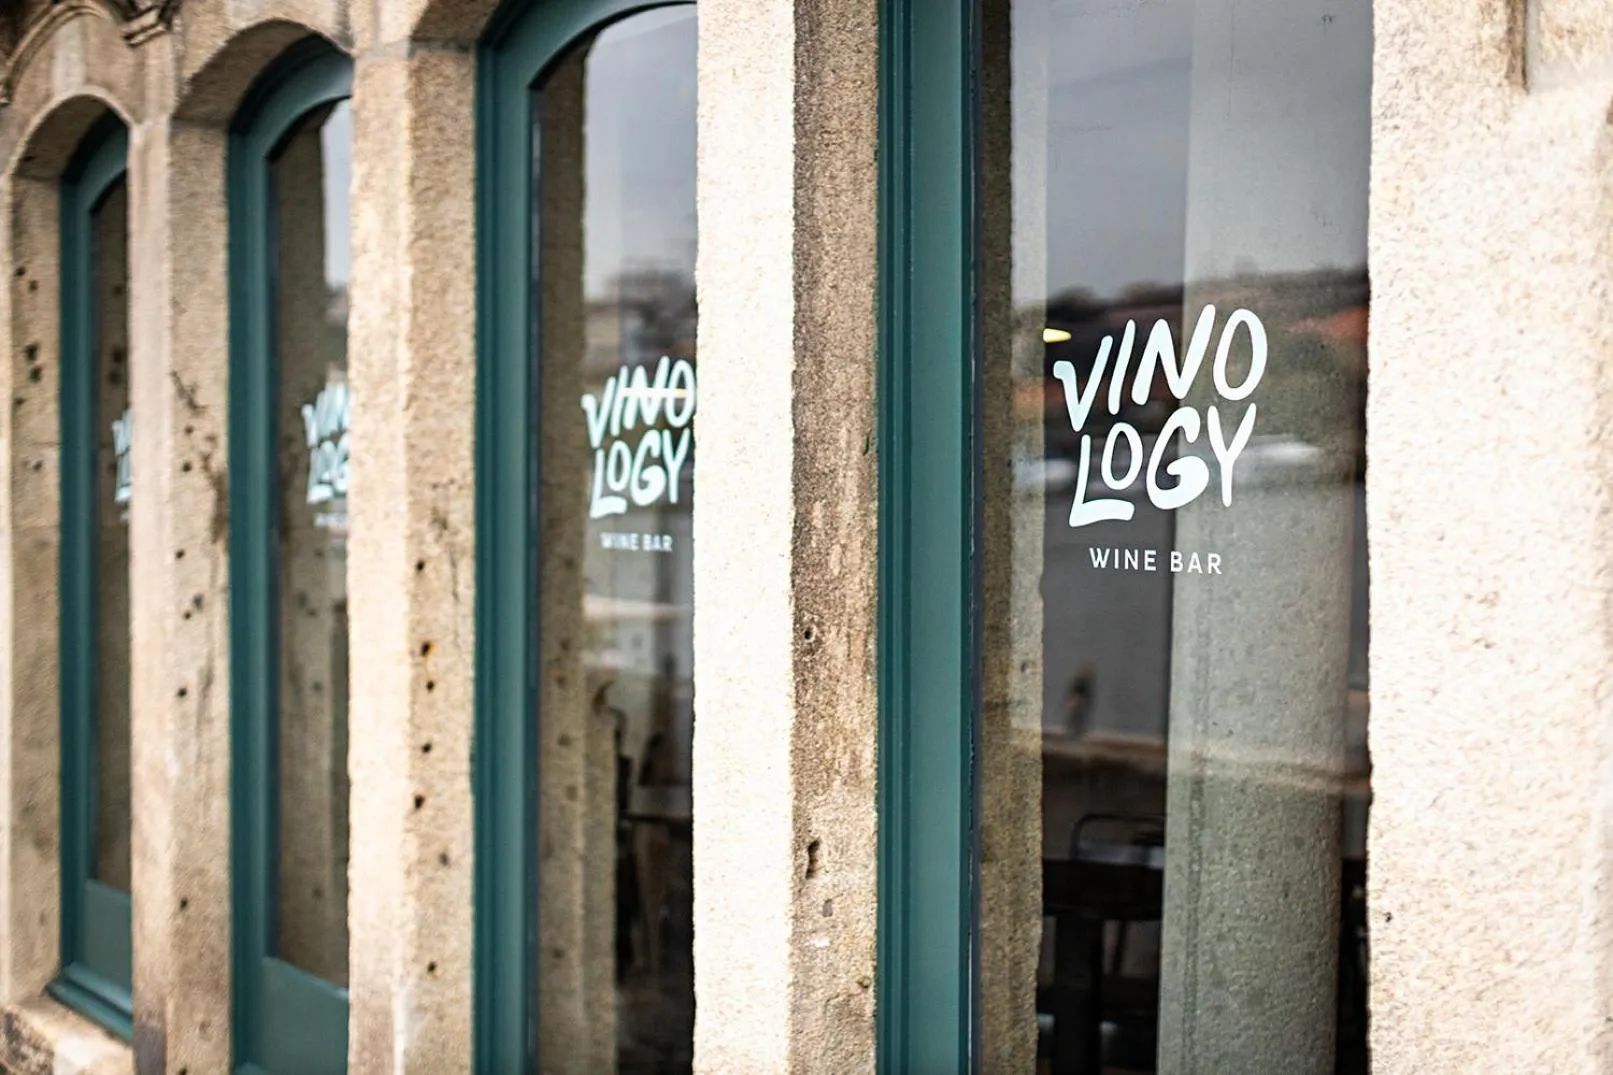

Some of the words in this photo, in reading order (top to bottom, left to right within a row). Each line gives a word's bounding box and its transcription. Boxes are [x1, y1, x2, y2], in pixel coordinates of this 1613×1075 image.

[580, 355, 696, 449] VINO
[1053, 304, 1268, 432] VINO
[306, 431, 350, 503] LOG
[589, 427, 691, 519] LOGY
[1069, 402, 1257, 527] LOGY
[601, 531, 640, 550] WINE
[642, 532, 673, 552] BAR
[1089, 547, 1157, 571] WINE
[1170, 551, 1222, 574] BAR
